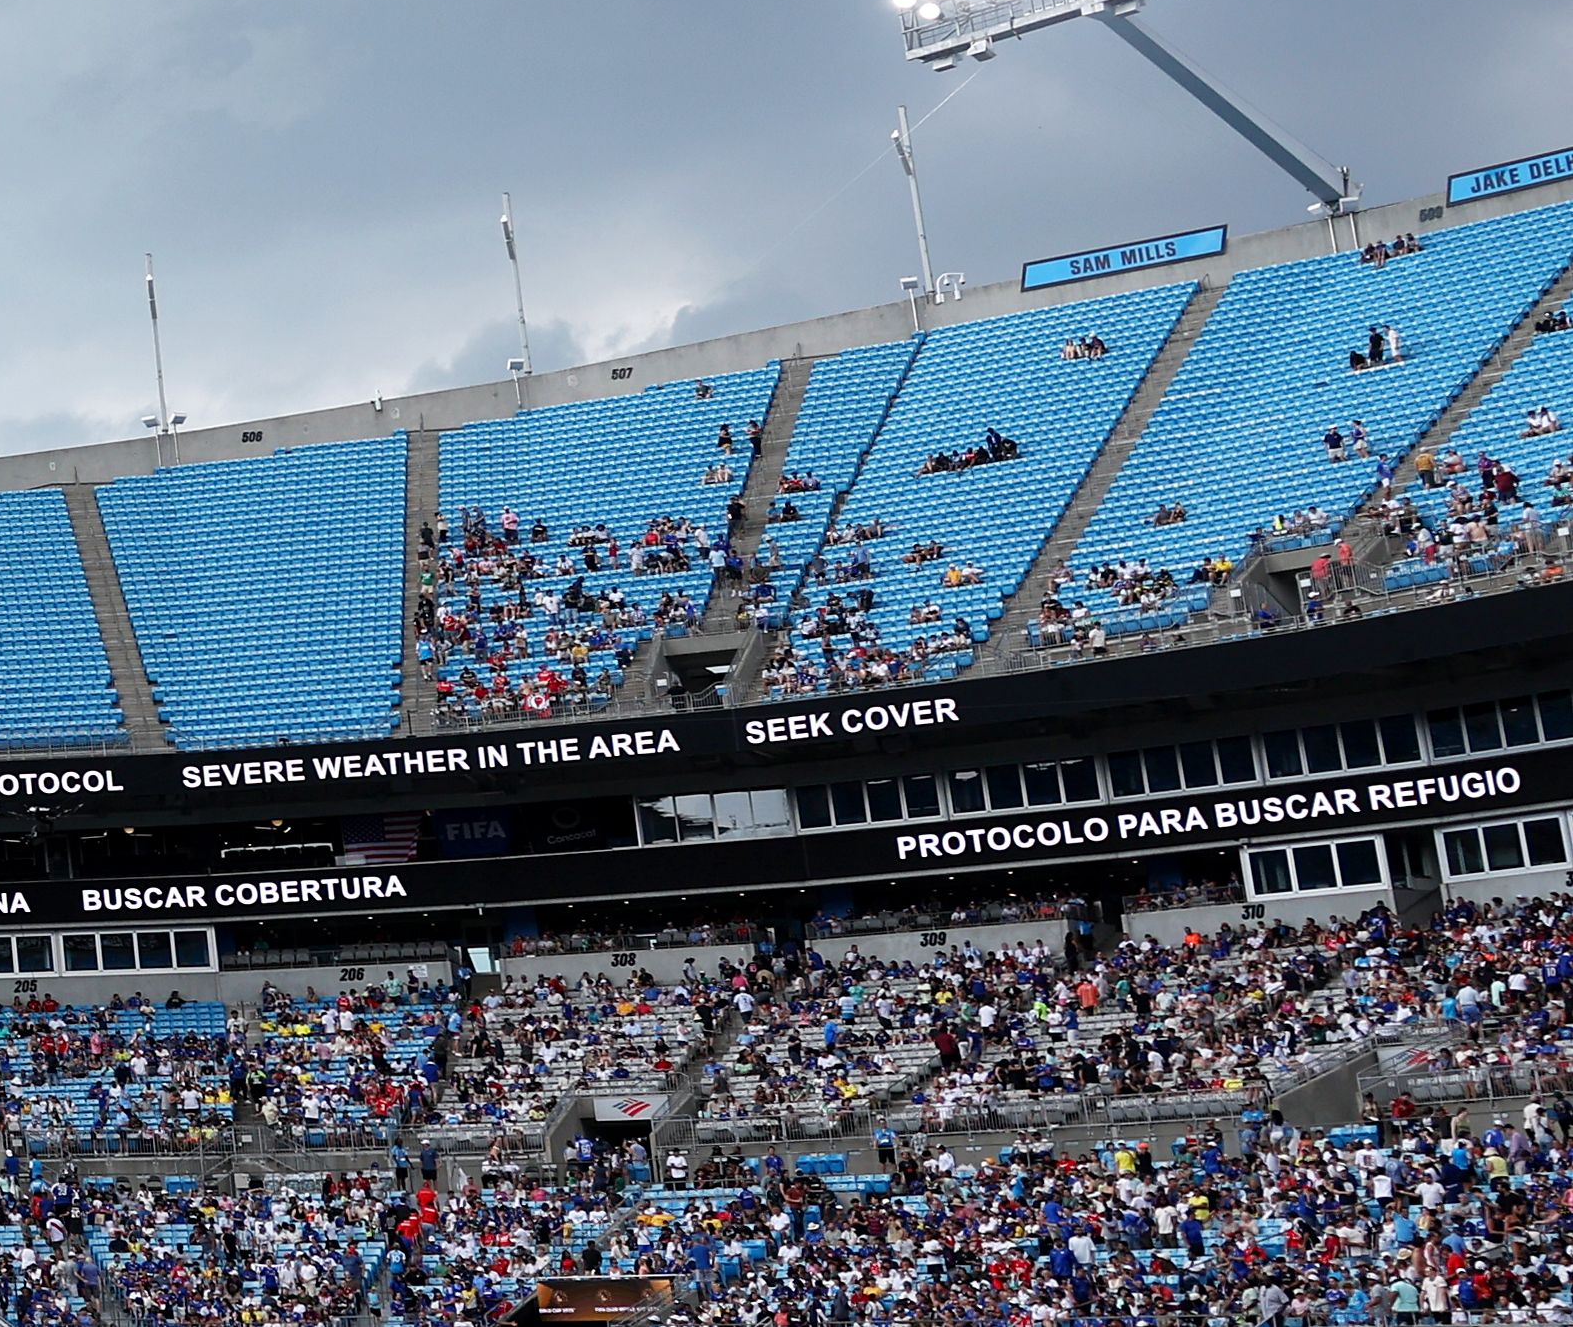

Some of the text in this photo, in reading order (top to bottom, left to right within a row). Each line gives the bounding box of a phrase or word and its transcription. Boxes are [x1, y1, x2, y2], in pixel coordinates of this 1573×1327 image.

[1470, 168, 1520, 193] JAKE
[1070, 242, 1176, 275] SAM MILLS
[611, 367, 633, 380] 507
[242, 431, 262, 443] 506
[745, 698, 960, 744] SEEK COVER
[182, 729, 681, 788] SEVERE WEATHER IN THE AREA
[896, 767, 1521, 860] PROTOCOLO PARA BUSCAR REFUGIO
[445, 820, 506, 841] FIFA
[81, 874, 408, 911] BUSCAR COBERTURA
[1241, 904, 1265, 920] 310
[920, 932, 947, 947] 309
[611, 952, 637, 967] 308
[339, 967, 365, 981] 206
[14, 980, 38, 994] 205
